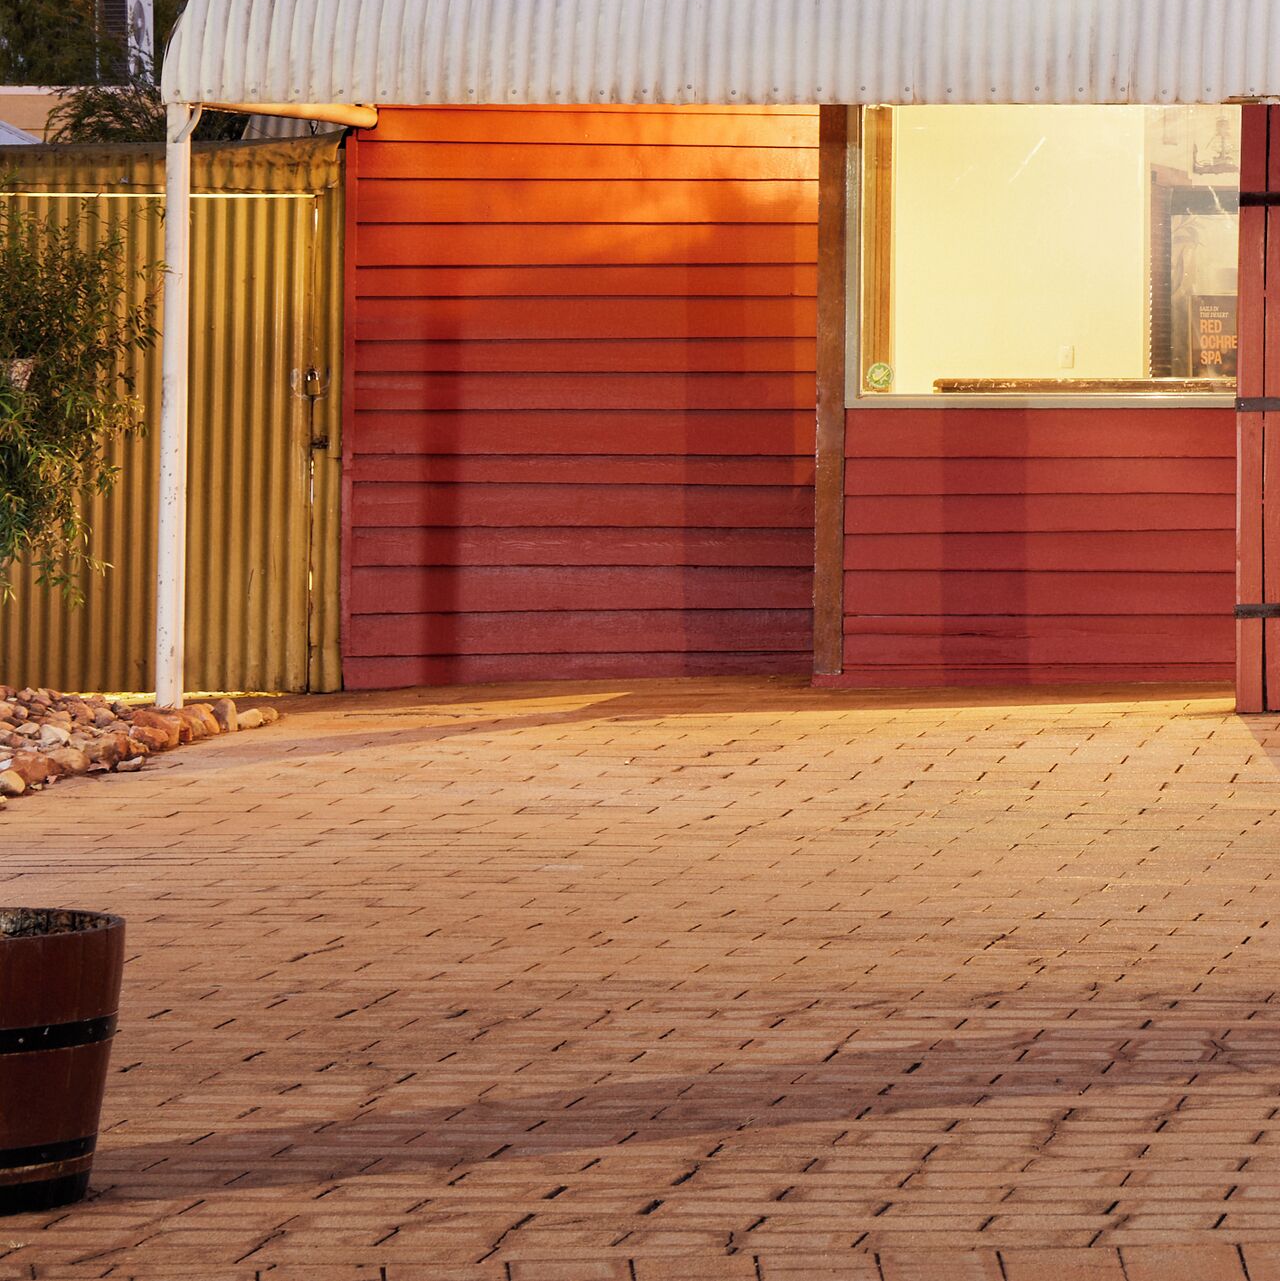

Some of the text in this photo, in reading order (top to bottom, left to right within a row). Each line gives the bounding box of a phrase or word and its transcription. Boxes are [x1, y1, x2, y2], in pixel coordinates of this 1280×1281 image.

[1200, 319, 1223, 333] RED
[1200, 335, 1238, 349] OCHRE
[1200, 350, 1223, 365] SPA
